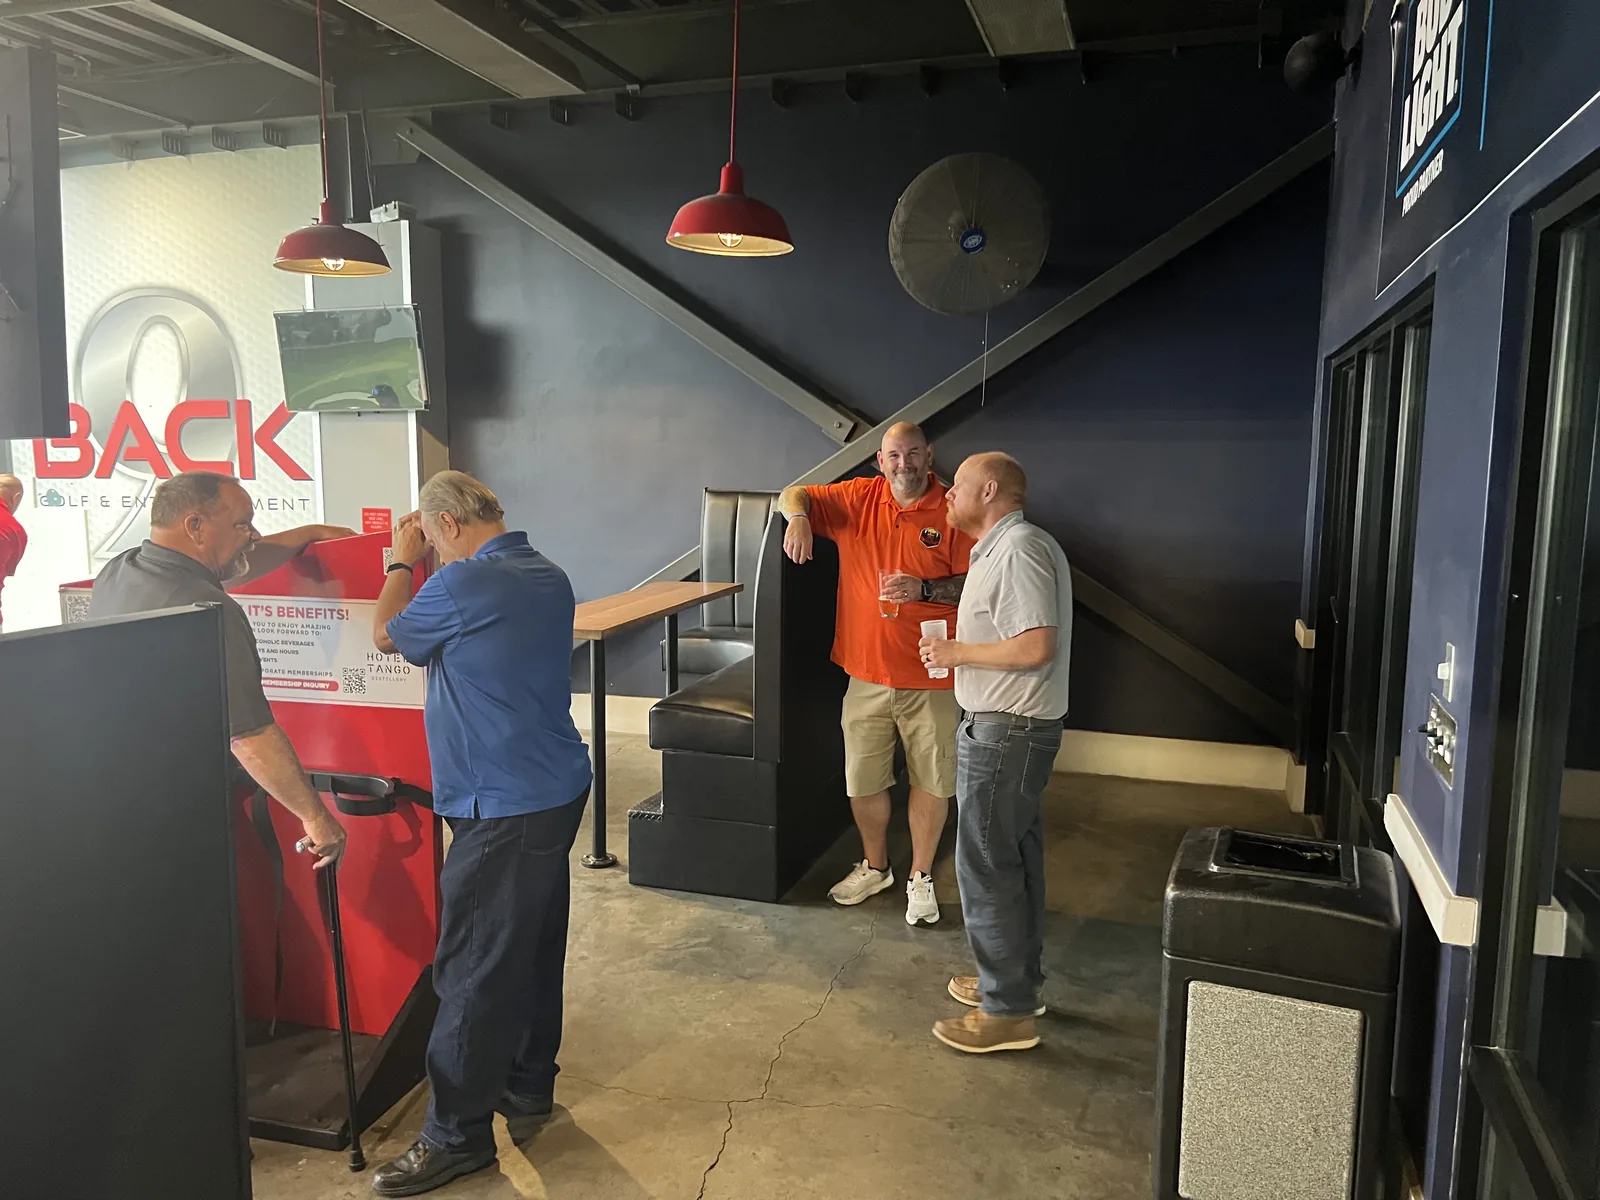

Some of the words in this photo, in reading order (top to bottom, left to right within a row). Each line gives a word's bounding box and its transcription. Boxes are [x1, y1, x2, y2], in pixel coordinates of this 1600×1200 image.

[33, 399, 314, 481] BACK
[100, 495, 110, 508] &
[248, 605, 273, 617] IT'S
[277, 606, 350, 621] BENEFITS!
[287, 669, 333, 677] MEMBERSHIPS
[367, 663, 411, 675] TANGO
